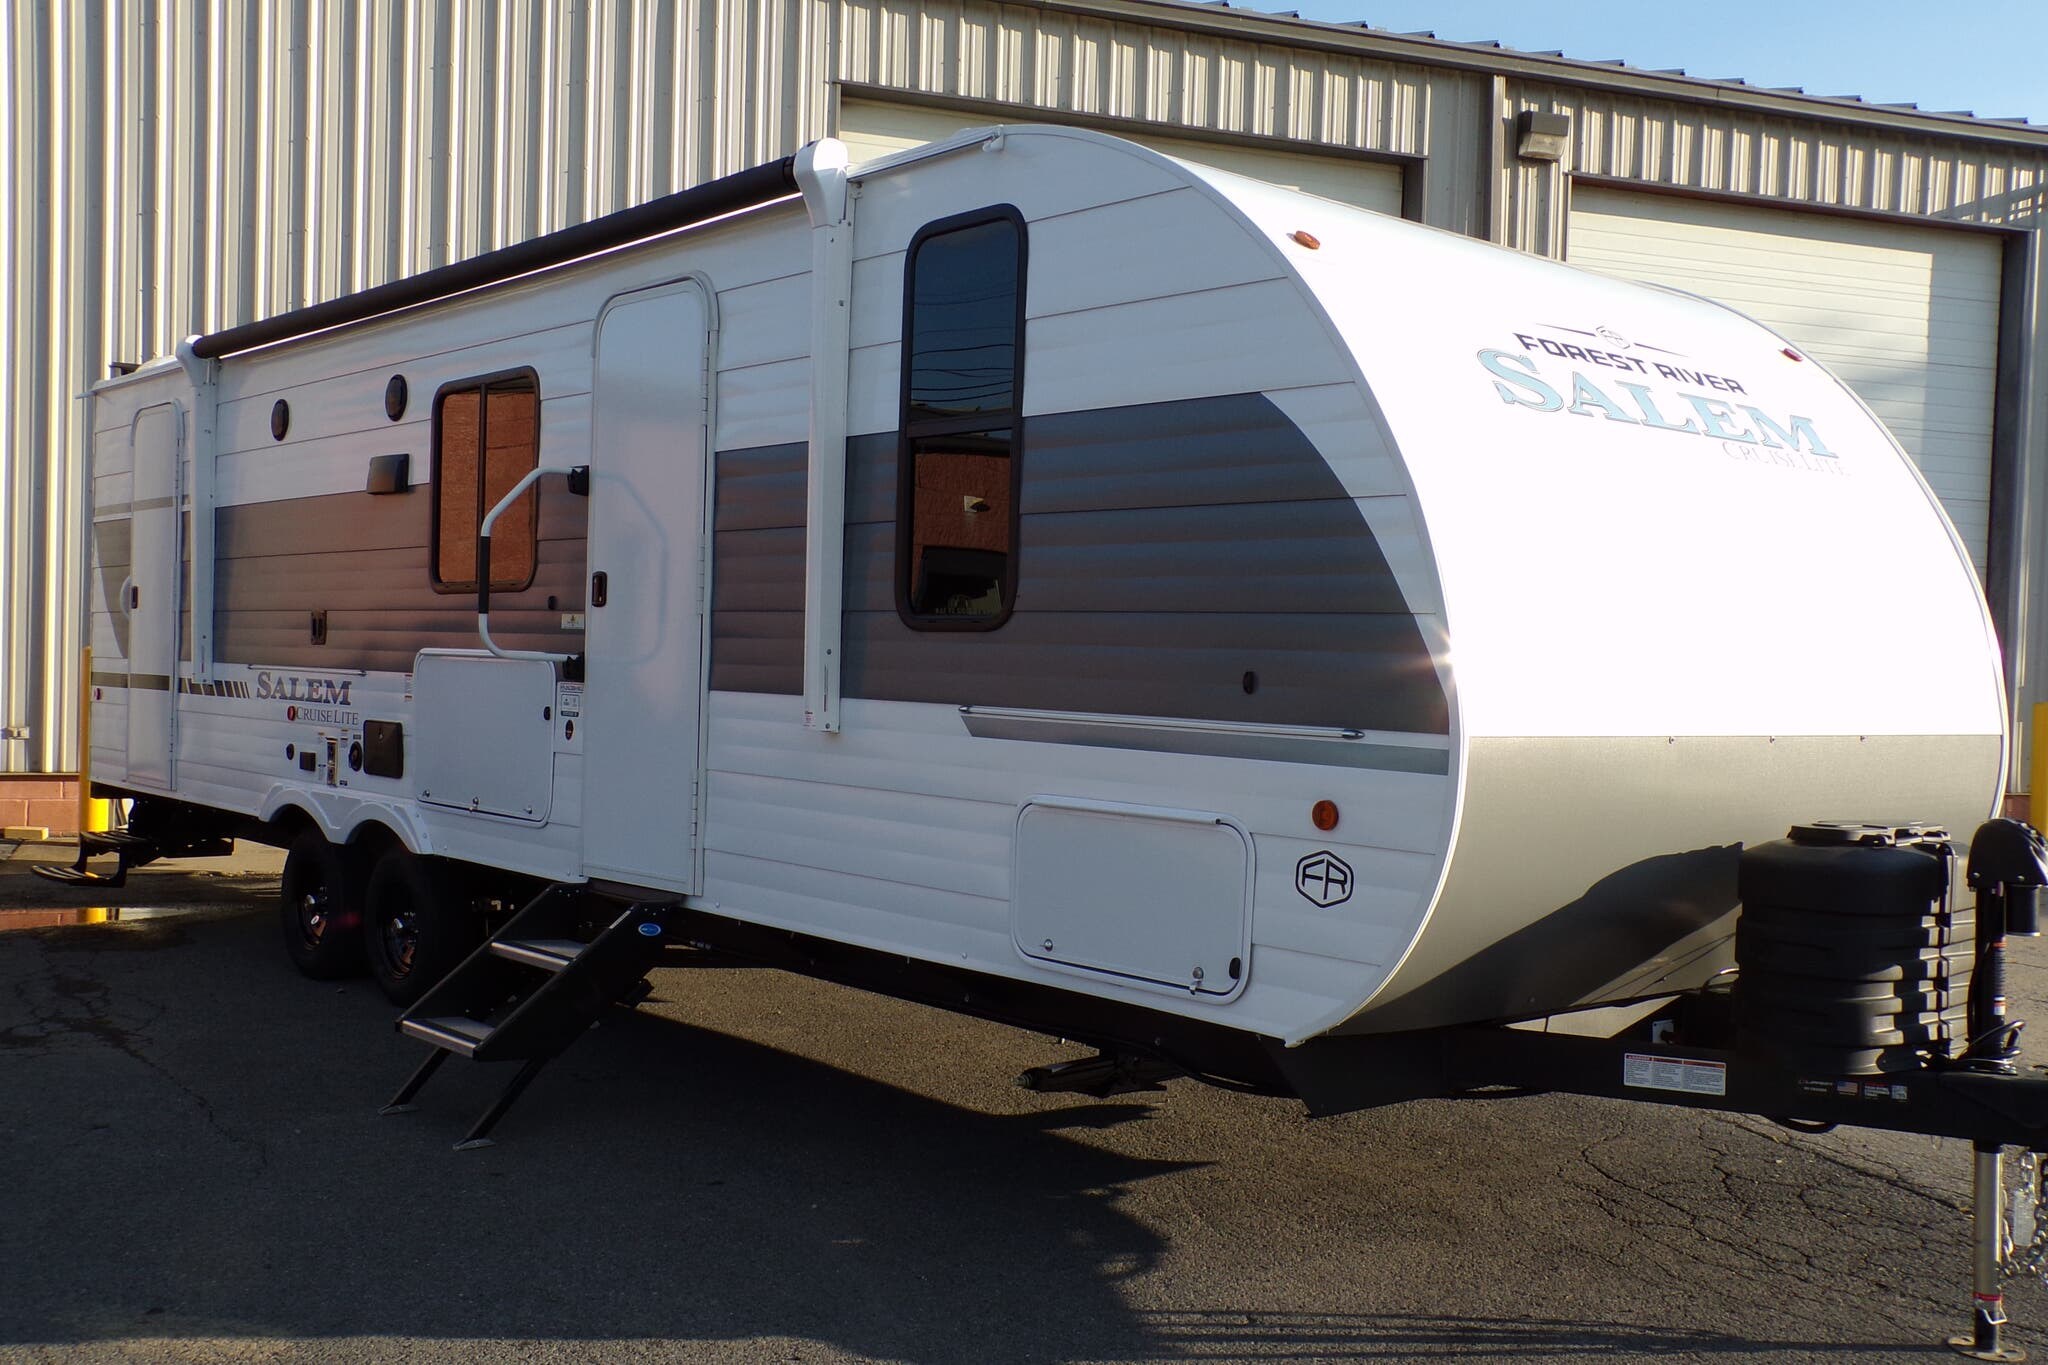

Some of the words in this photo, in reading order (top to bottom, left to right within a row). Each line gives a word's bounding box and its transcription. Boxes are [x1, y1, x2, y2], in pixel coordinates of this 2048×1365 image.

[1513, 333, 1649, 375] FOREST
[1653, 362, 1748, 395] RIVER
[1476, 347, 1840, 458] SALEM
[257, 671, 352, 705] SALEM
